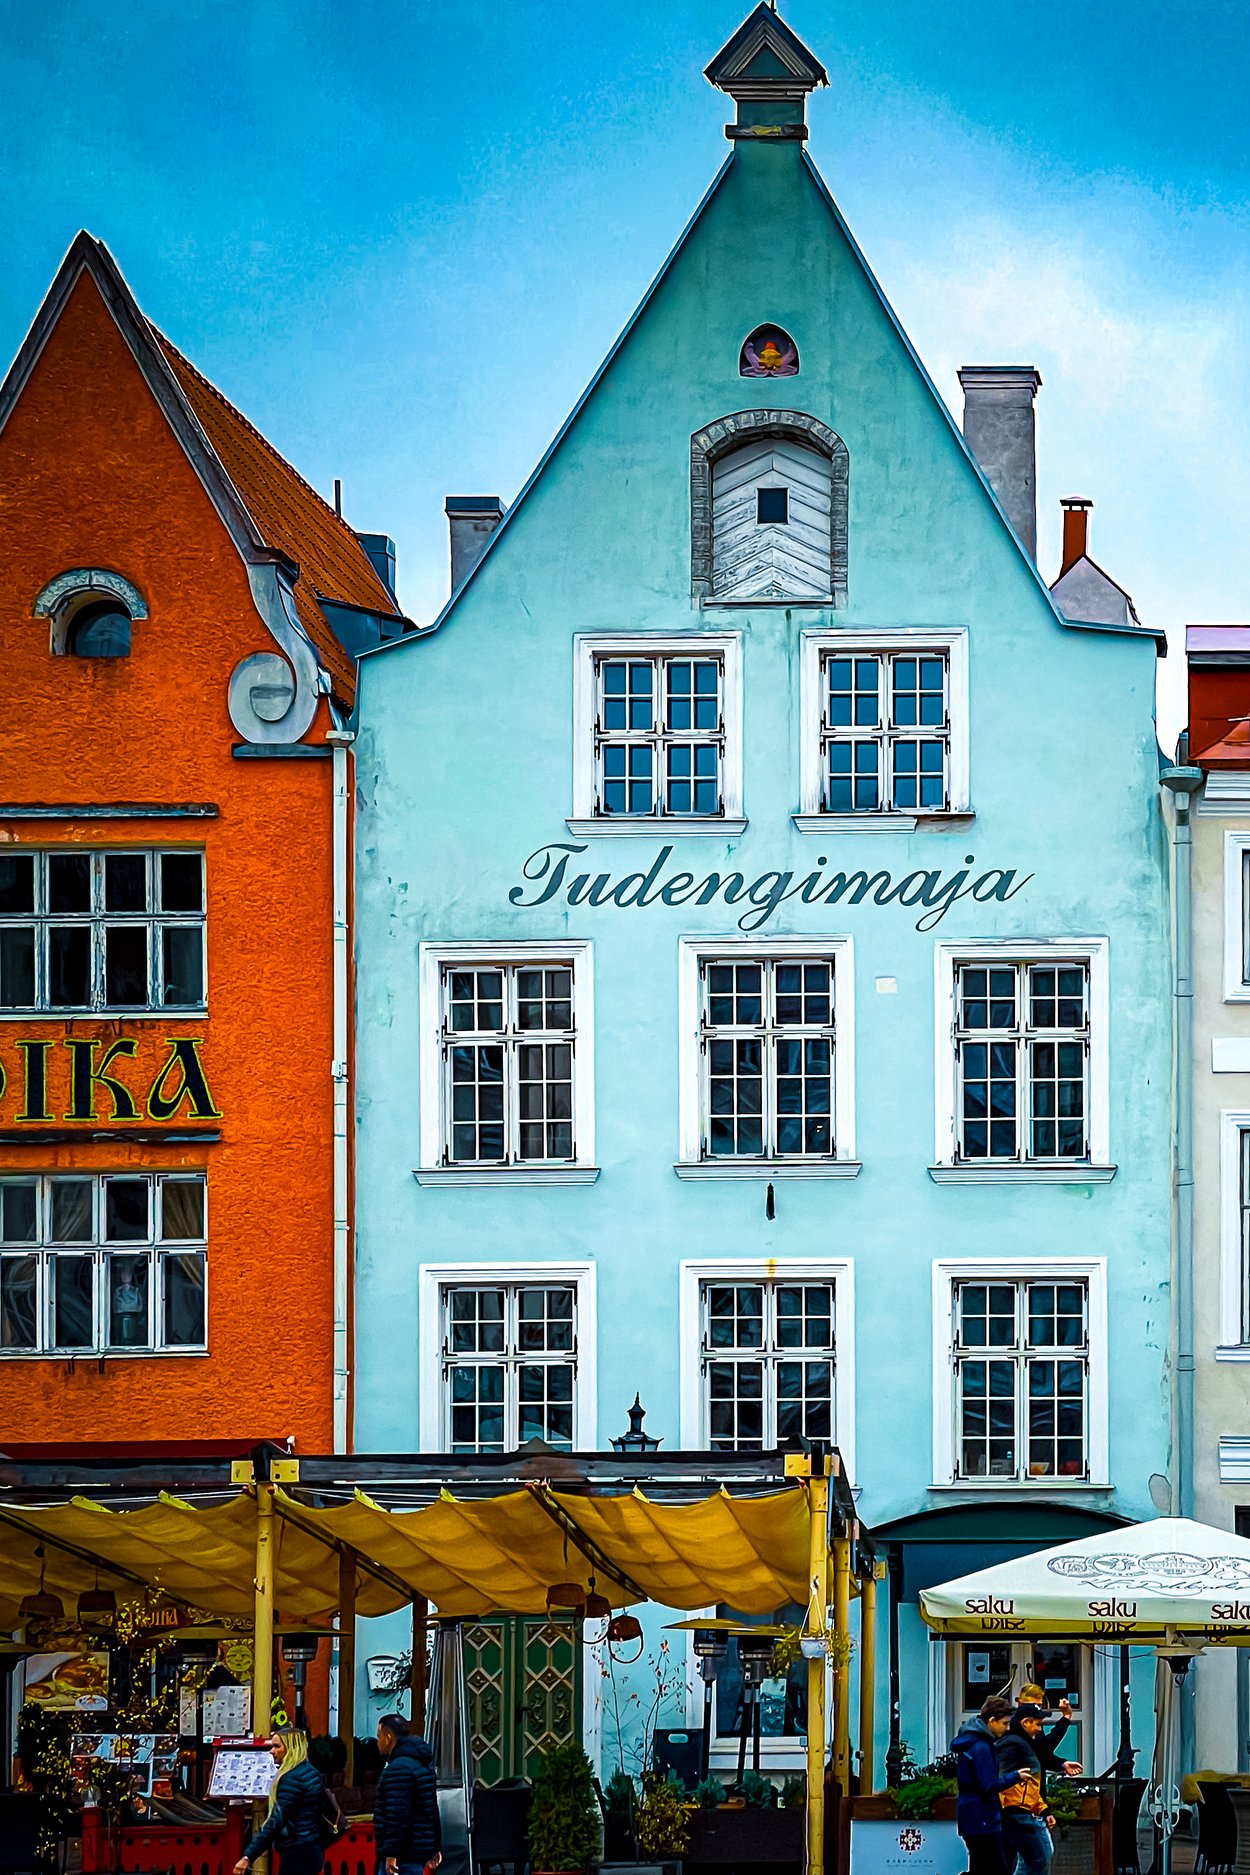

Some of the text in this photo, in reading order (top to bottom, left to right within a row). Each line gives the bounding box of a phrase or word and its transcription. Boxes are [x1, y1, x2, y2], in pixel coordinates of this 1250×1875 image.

[508, 844, 1035, 932] Tudengimaja
[0, 1038, 223, 1121] IKA
[965, 1595, 1014, 1614] saku
[1088, 1597, 1137, 1617] saku
